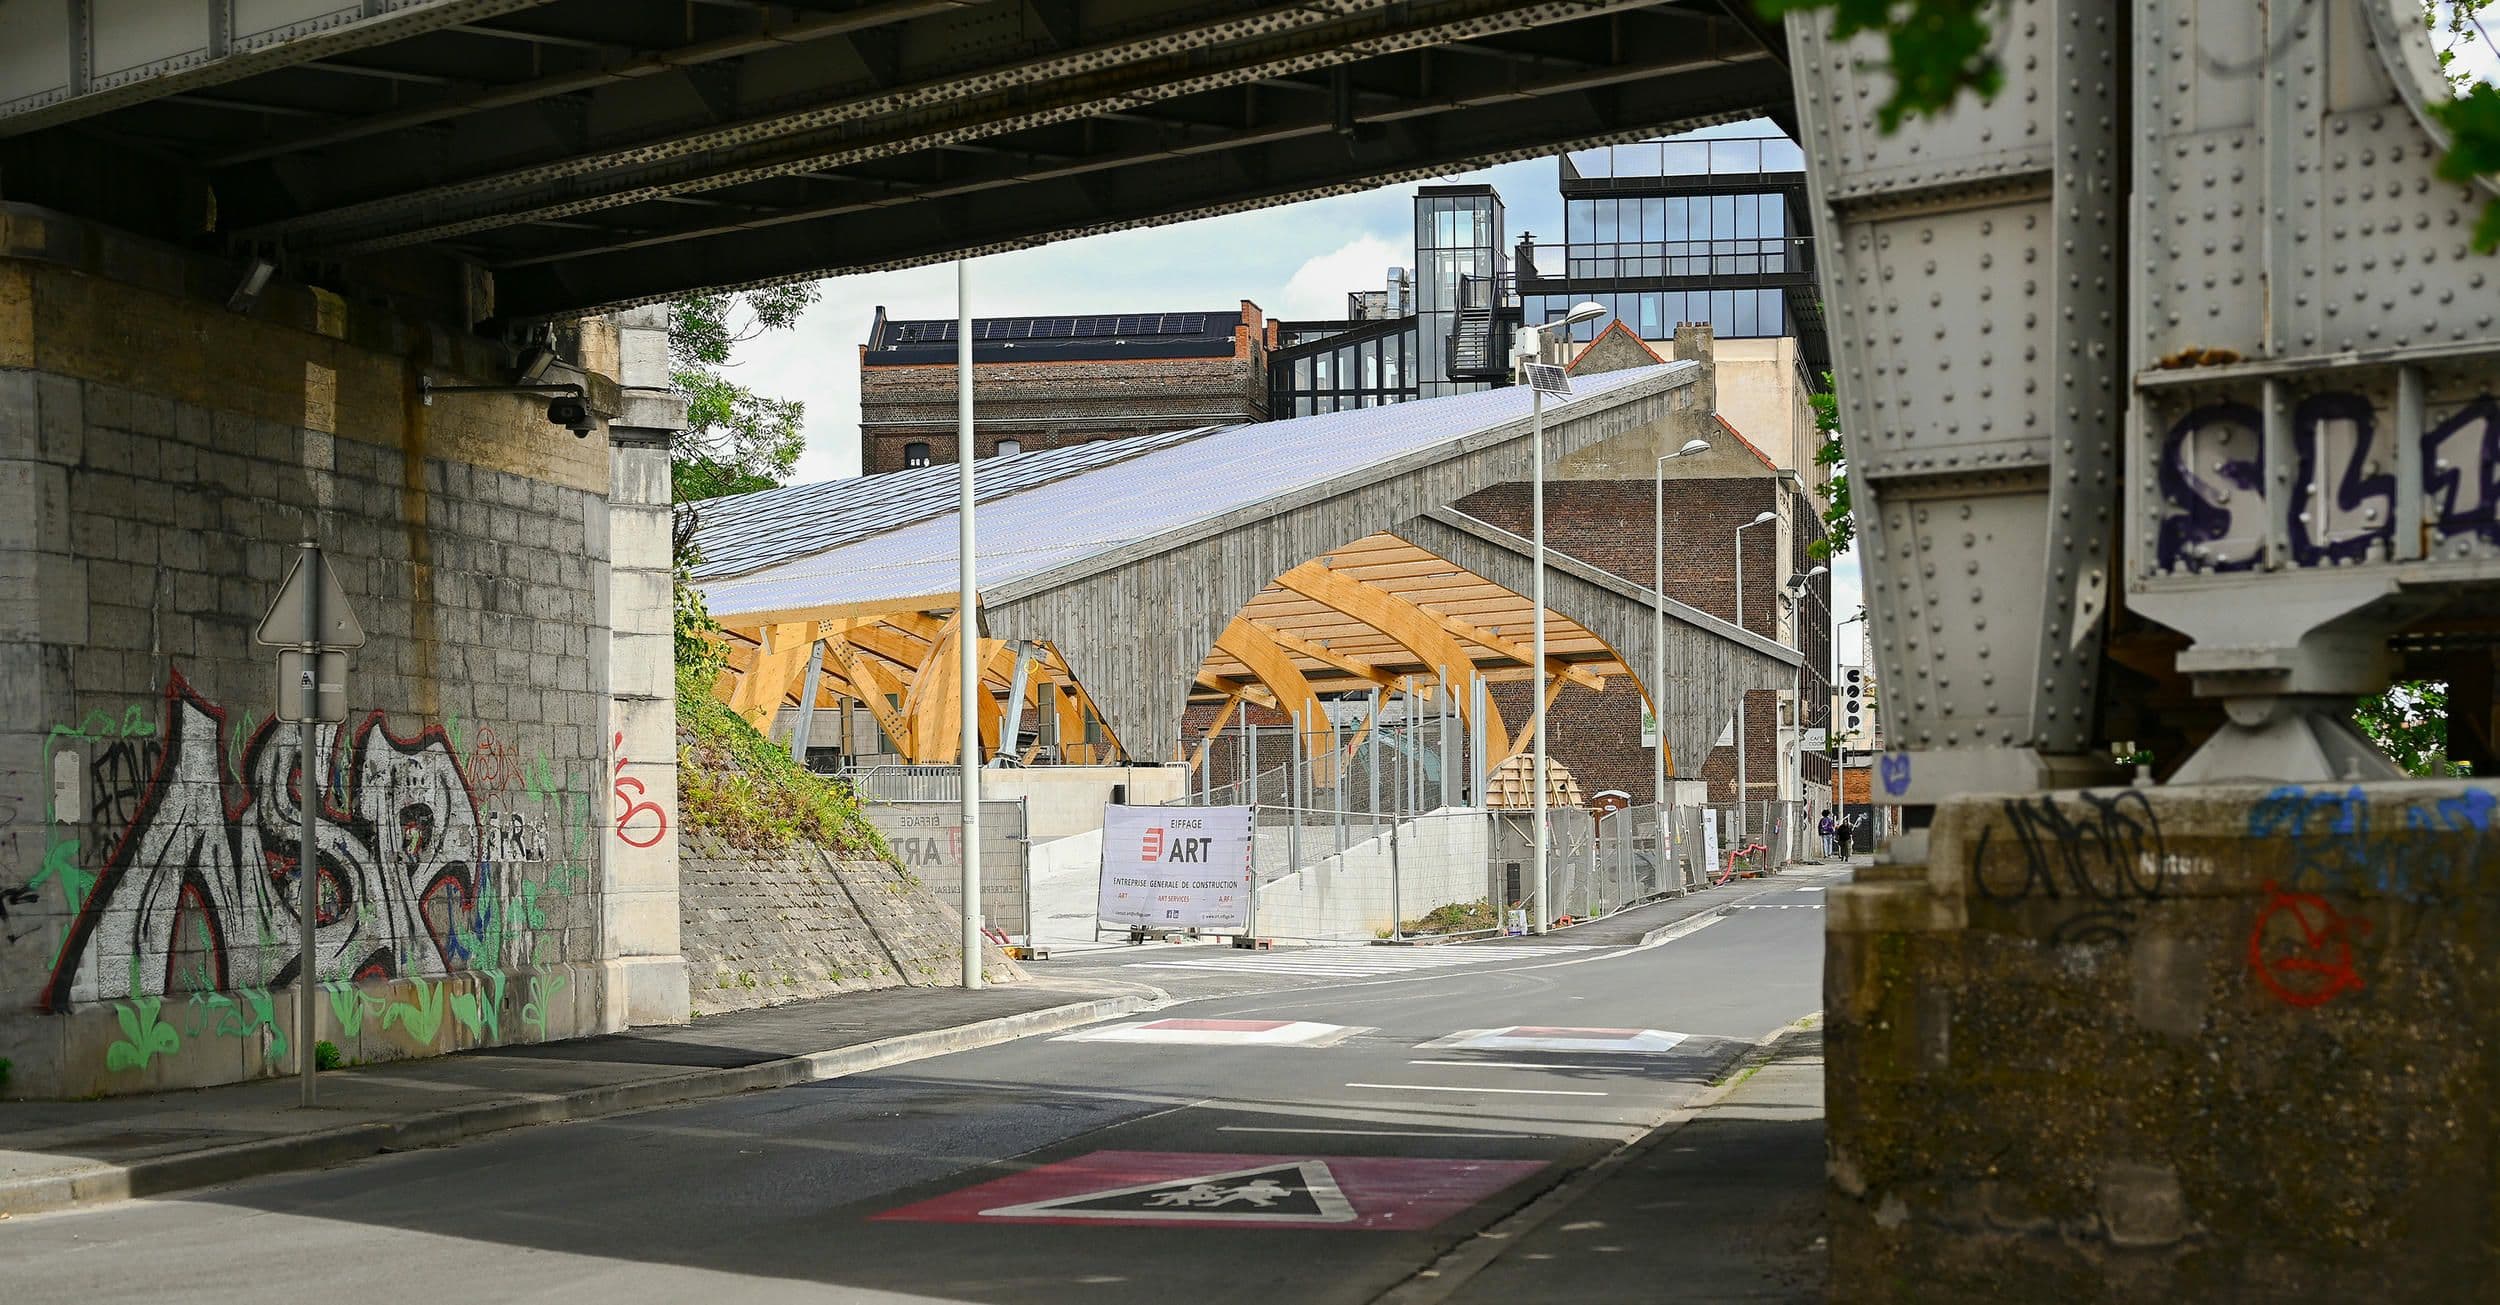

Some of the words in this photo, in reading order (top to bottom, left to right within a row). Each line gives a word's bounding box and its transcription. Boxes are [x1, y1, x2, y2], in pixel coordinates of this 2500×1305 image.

[1847, 670, 1859, 728] COOP
[1171, 819, 1203, 829] EIFFAGE
[1169, 838, 1212, 863] ART
[1113, 877, 1146, 888] ENTREPRISE
[1181, 880, 1190, 889] DE
[1192, 880, 1238, 889] CONSTRUCTION
